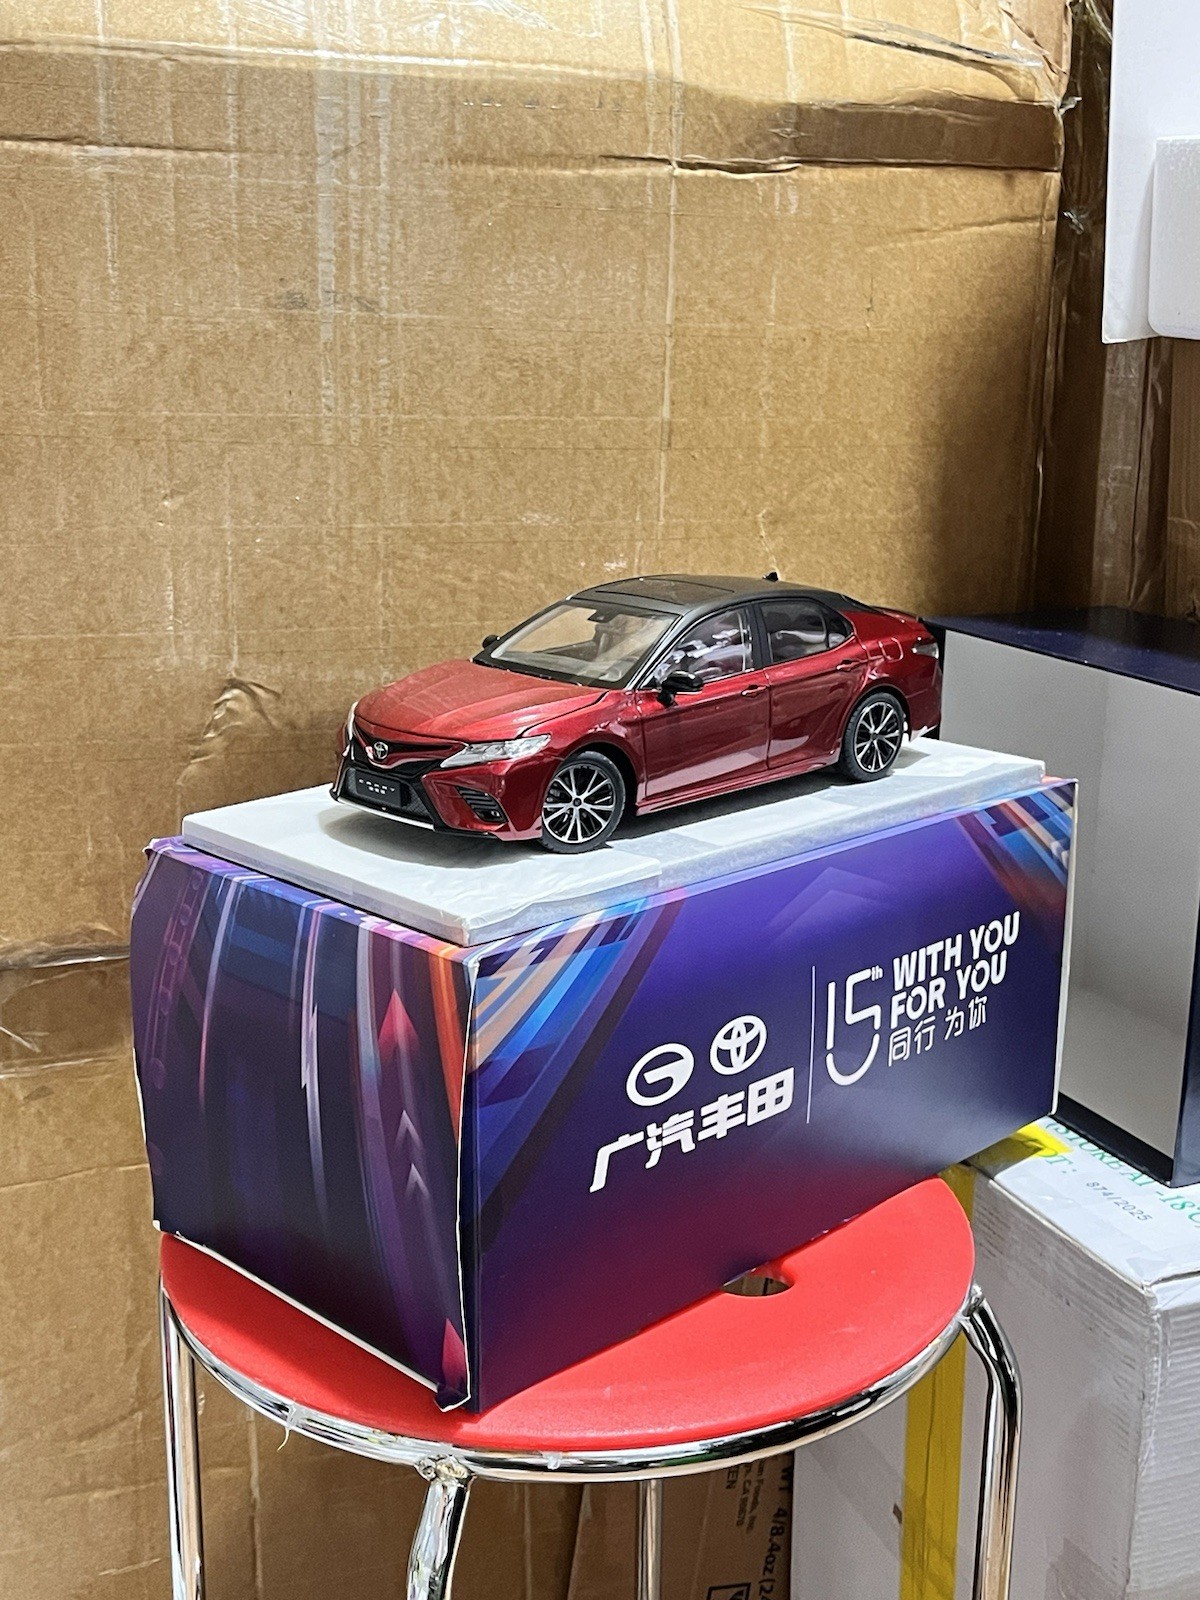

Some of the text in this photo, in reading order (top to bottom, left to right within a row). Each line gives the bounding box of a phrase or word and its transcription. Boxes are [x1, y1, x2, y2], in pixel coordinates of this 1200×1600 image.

[890, 950, 1007, 1029] FOR YOU
[893, 911, 1020, 991] WITH YOU
[888, 995, 988, 1067] 同行 为你
[589, 1067, 795, 1193] 广汽丰田
